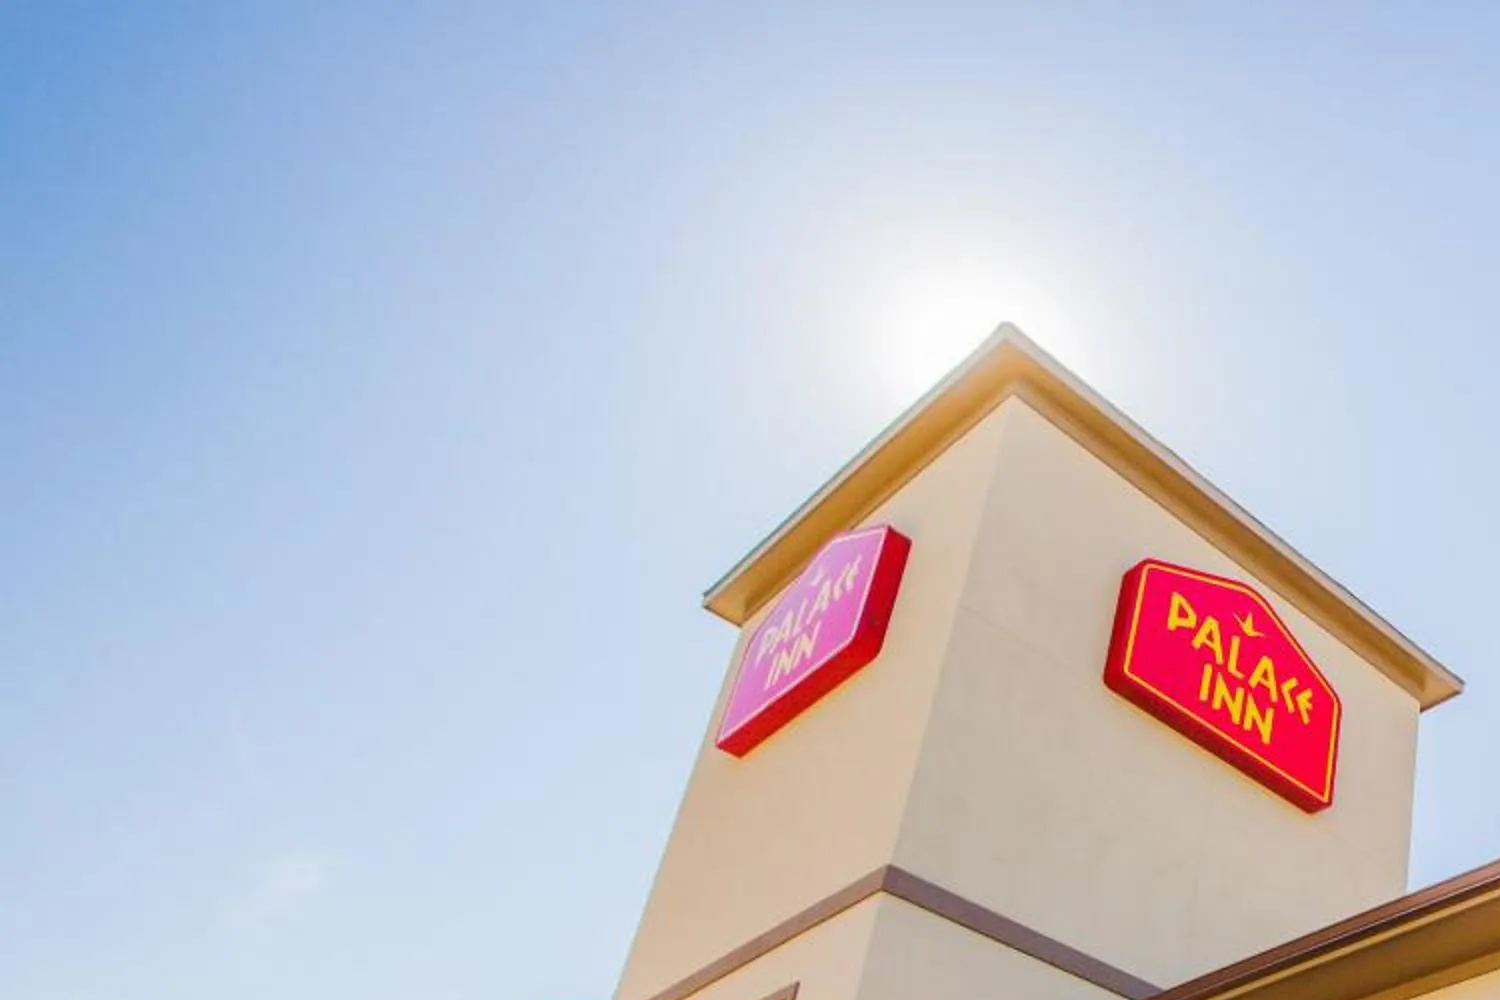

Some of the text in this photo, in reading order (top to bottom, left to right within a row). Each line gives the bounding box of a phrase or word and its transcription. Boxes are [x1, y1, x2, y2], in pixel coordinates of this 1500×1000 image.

[754, 556, 862, 669] PALACE
[764, 619, 822, 691] INN
[1167, 591, 1313, 725] PALACE
[1199, 663, 1275, 744] INN
